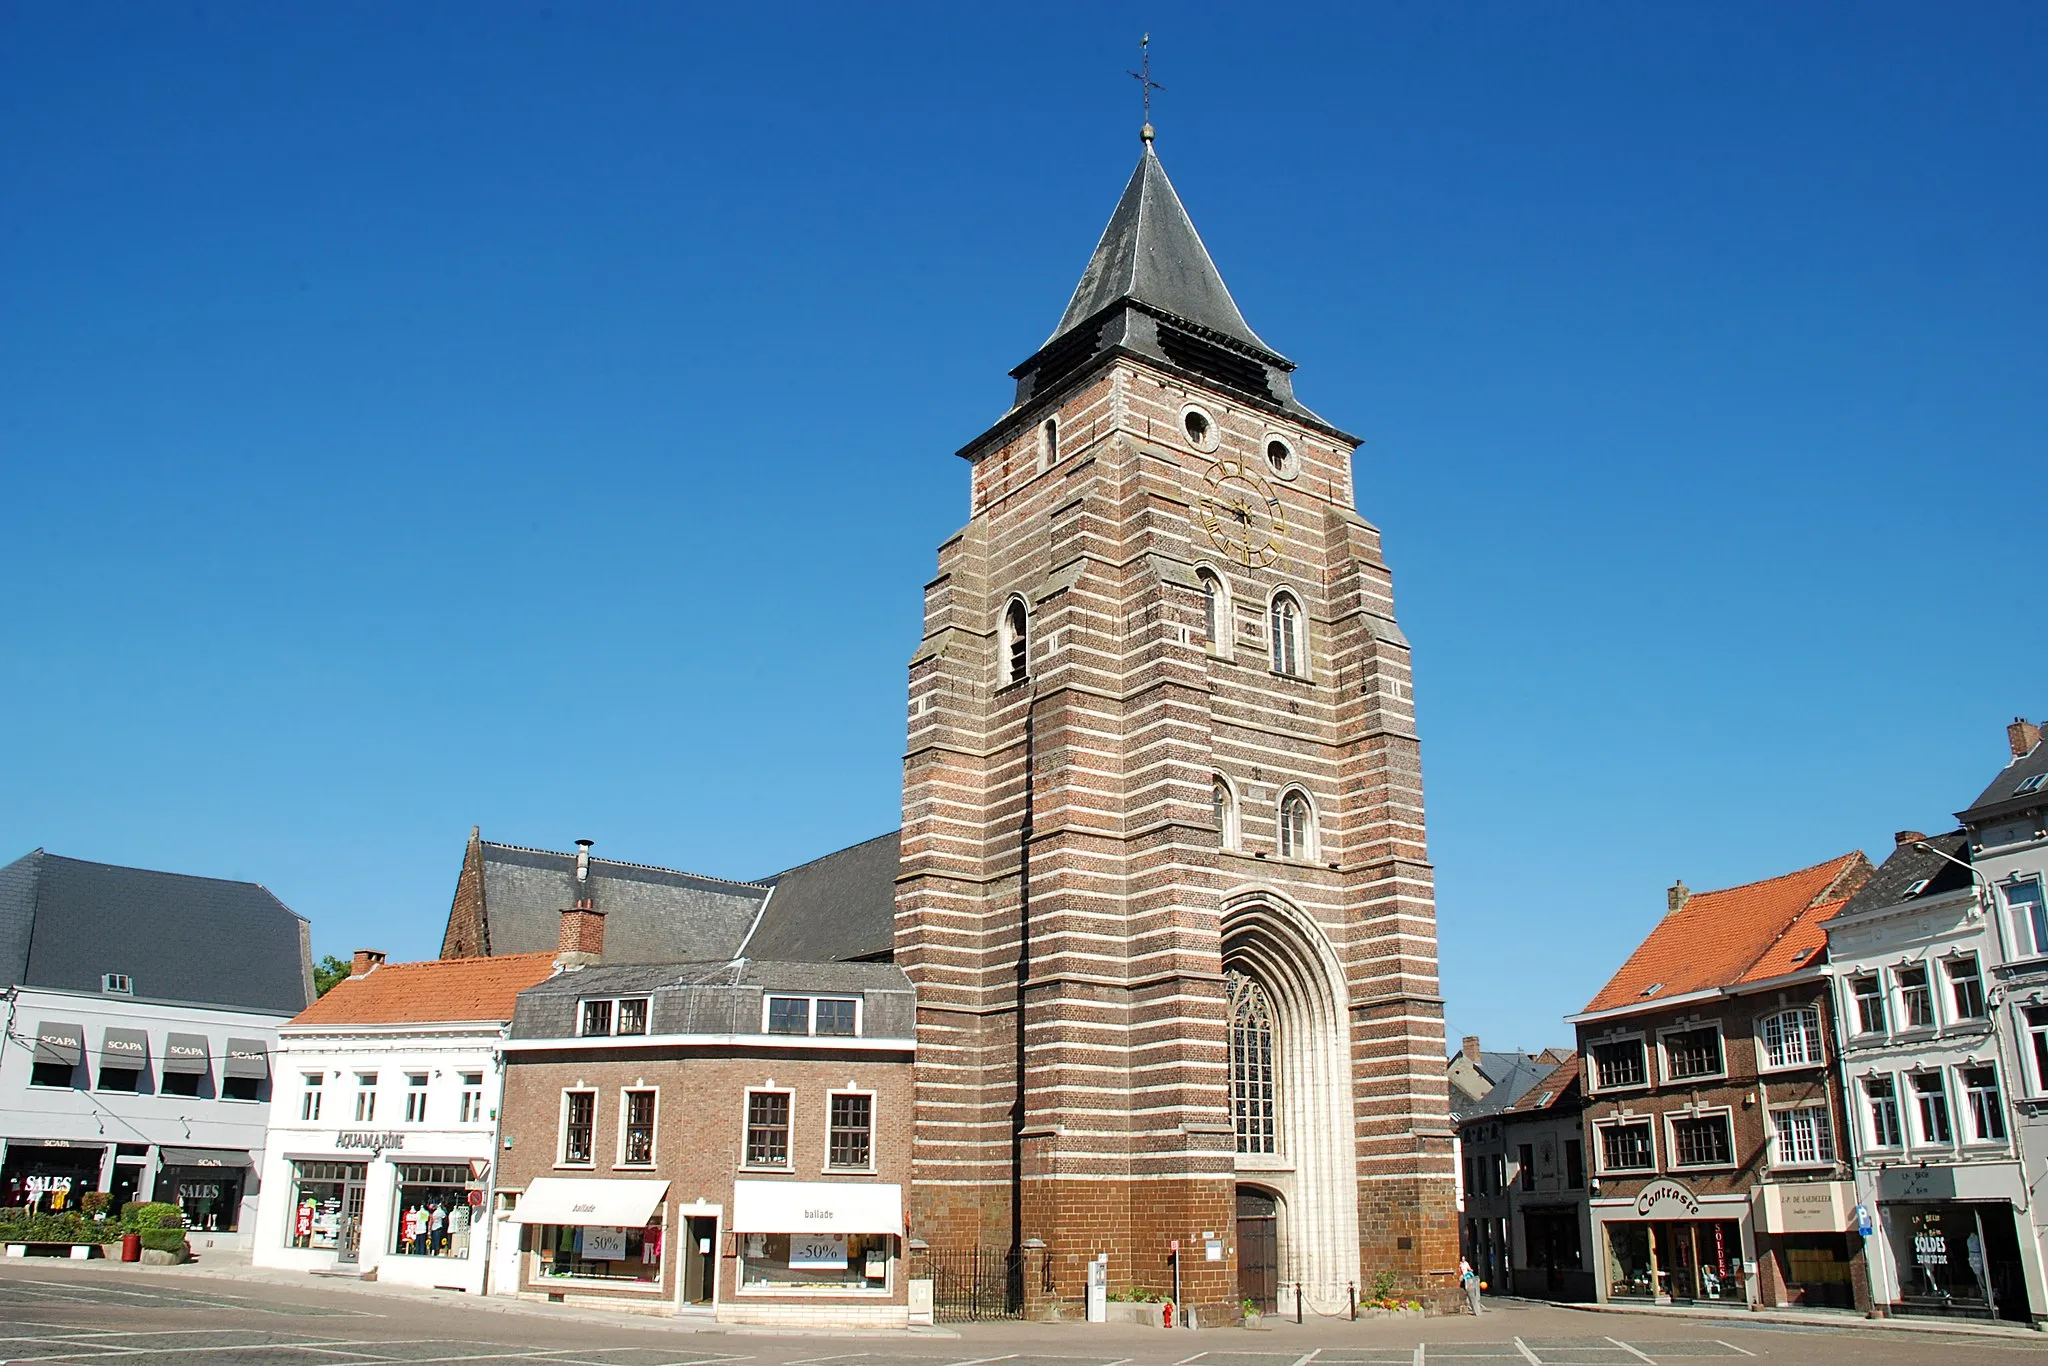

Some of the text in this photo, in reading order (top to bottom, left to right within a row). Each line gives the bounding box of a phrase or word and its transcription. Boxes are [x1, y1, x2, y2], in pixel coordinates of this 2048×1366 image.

[41, 1035, 77, 1046] SCAPA
[108, 1040, 143, 1050] SCAPA
[171, 1045, 204, 1056] SCAPA
[231, 1051, 264, 1060] SCAPA
[44, 1139, 70, 1148] SCAPA
[197, 1159, 222, 1167] SCAPA
[25, 1176, 72, 1191] SALES
[180, 1183, 220, 1199] SALES
[1638, 1187, 1699, 1216] Contraste
[572, 1204, 596, 1213] ballade
[804, 1209, 834, 1219] ballade
[1858, 1207, 1867, 1225] P
[589, 1236, 619, 1250] -50%
[1915, 1236, 1945, 1253] SOLDES
[799, 1244, 837, 1258] -50%
[1715, 1223, 1726, 1277] SOLDES
